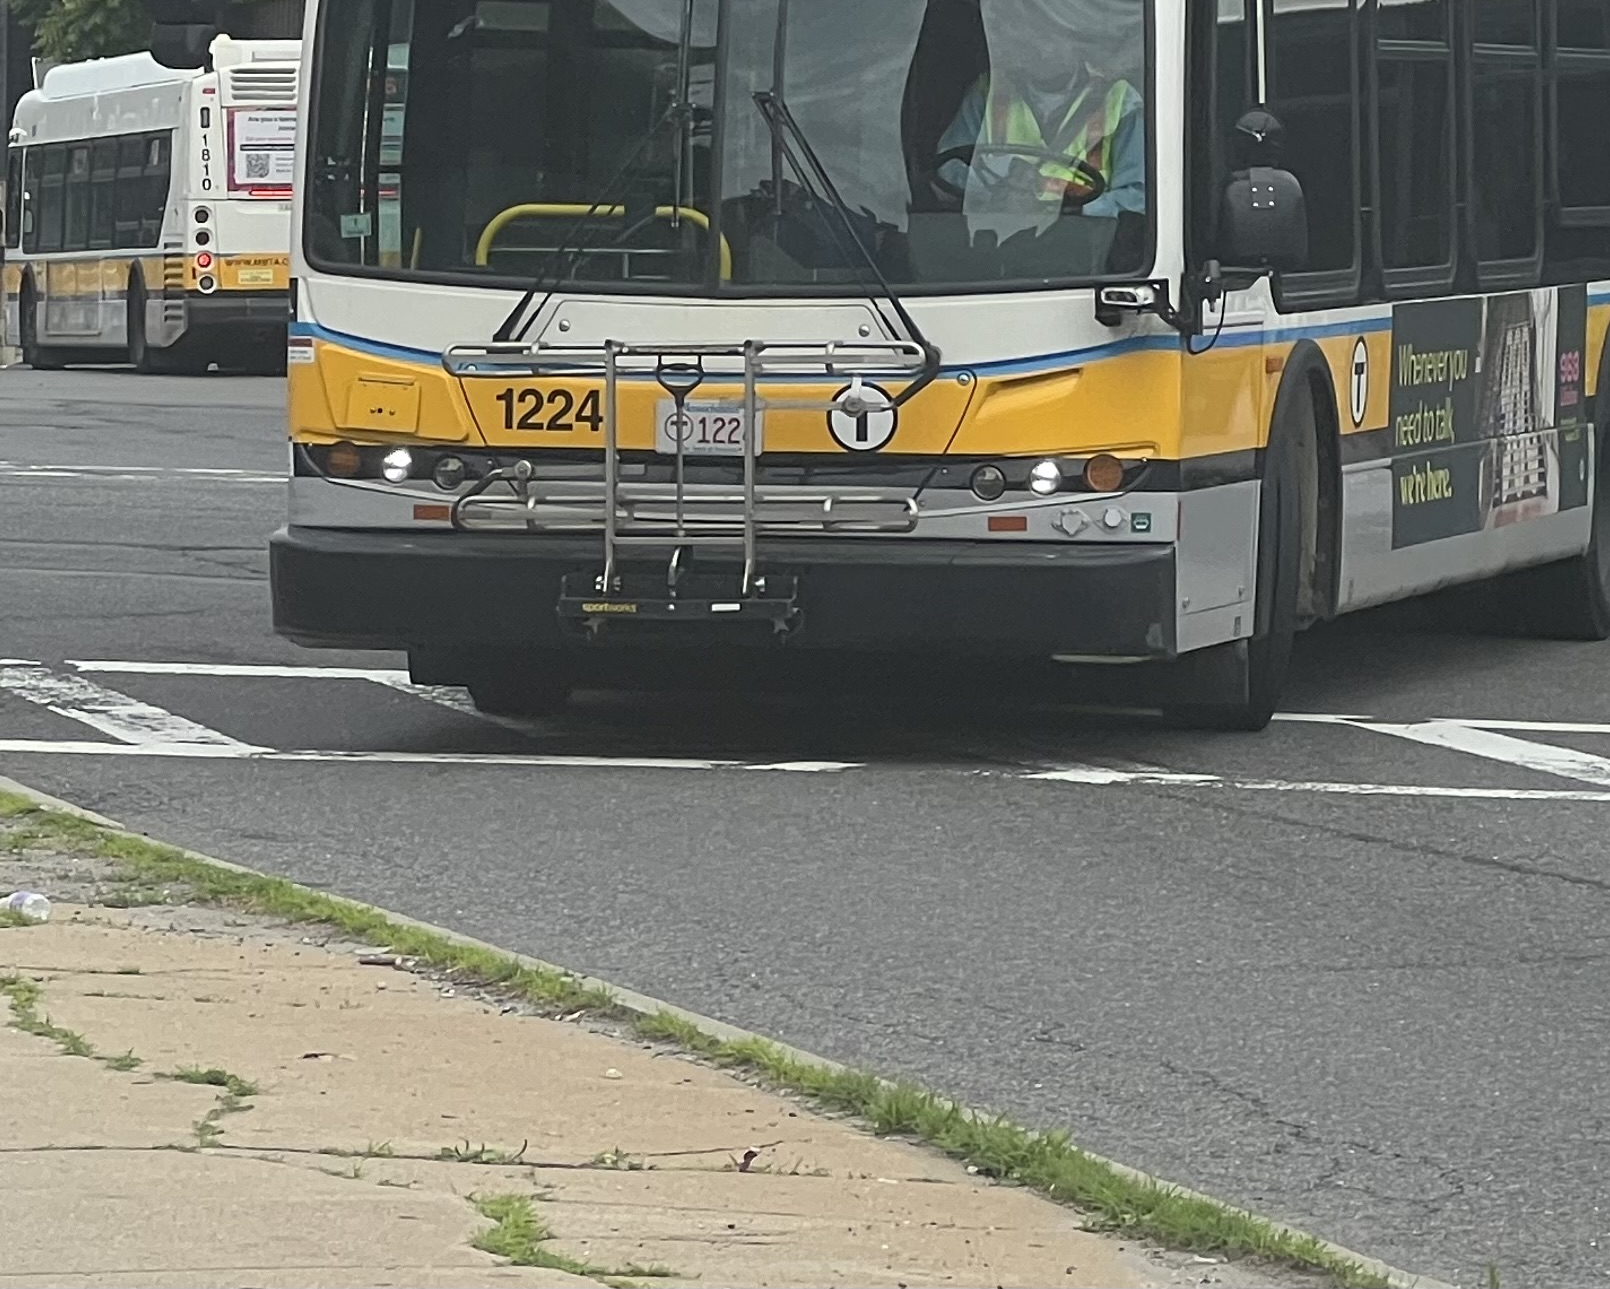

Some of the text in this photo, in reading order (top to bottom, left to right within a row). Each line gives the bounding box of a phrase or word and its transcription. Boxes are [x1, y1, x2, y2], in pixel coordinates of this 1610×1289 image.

[202, 133, 211, 191] 1810
[1398, 343, 1468, 391] Whenever you
[496, 388, 604, 432] 1224
[697, 416, 746, 445] 122
[1395, 400, 1422, 446] need
[1423, 403, 1434, 443] to
